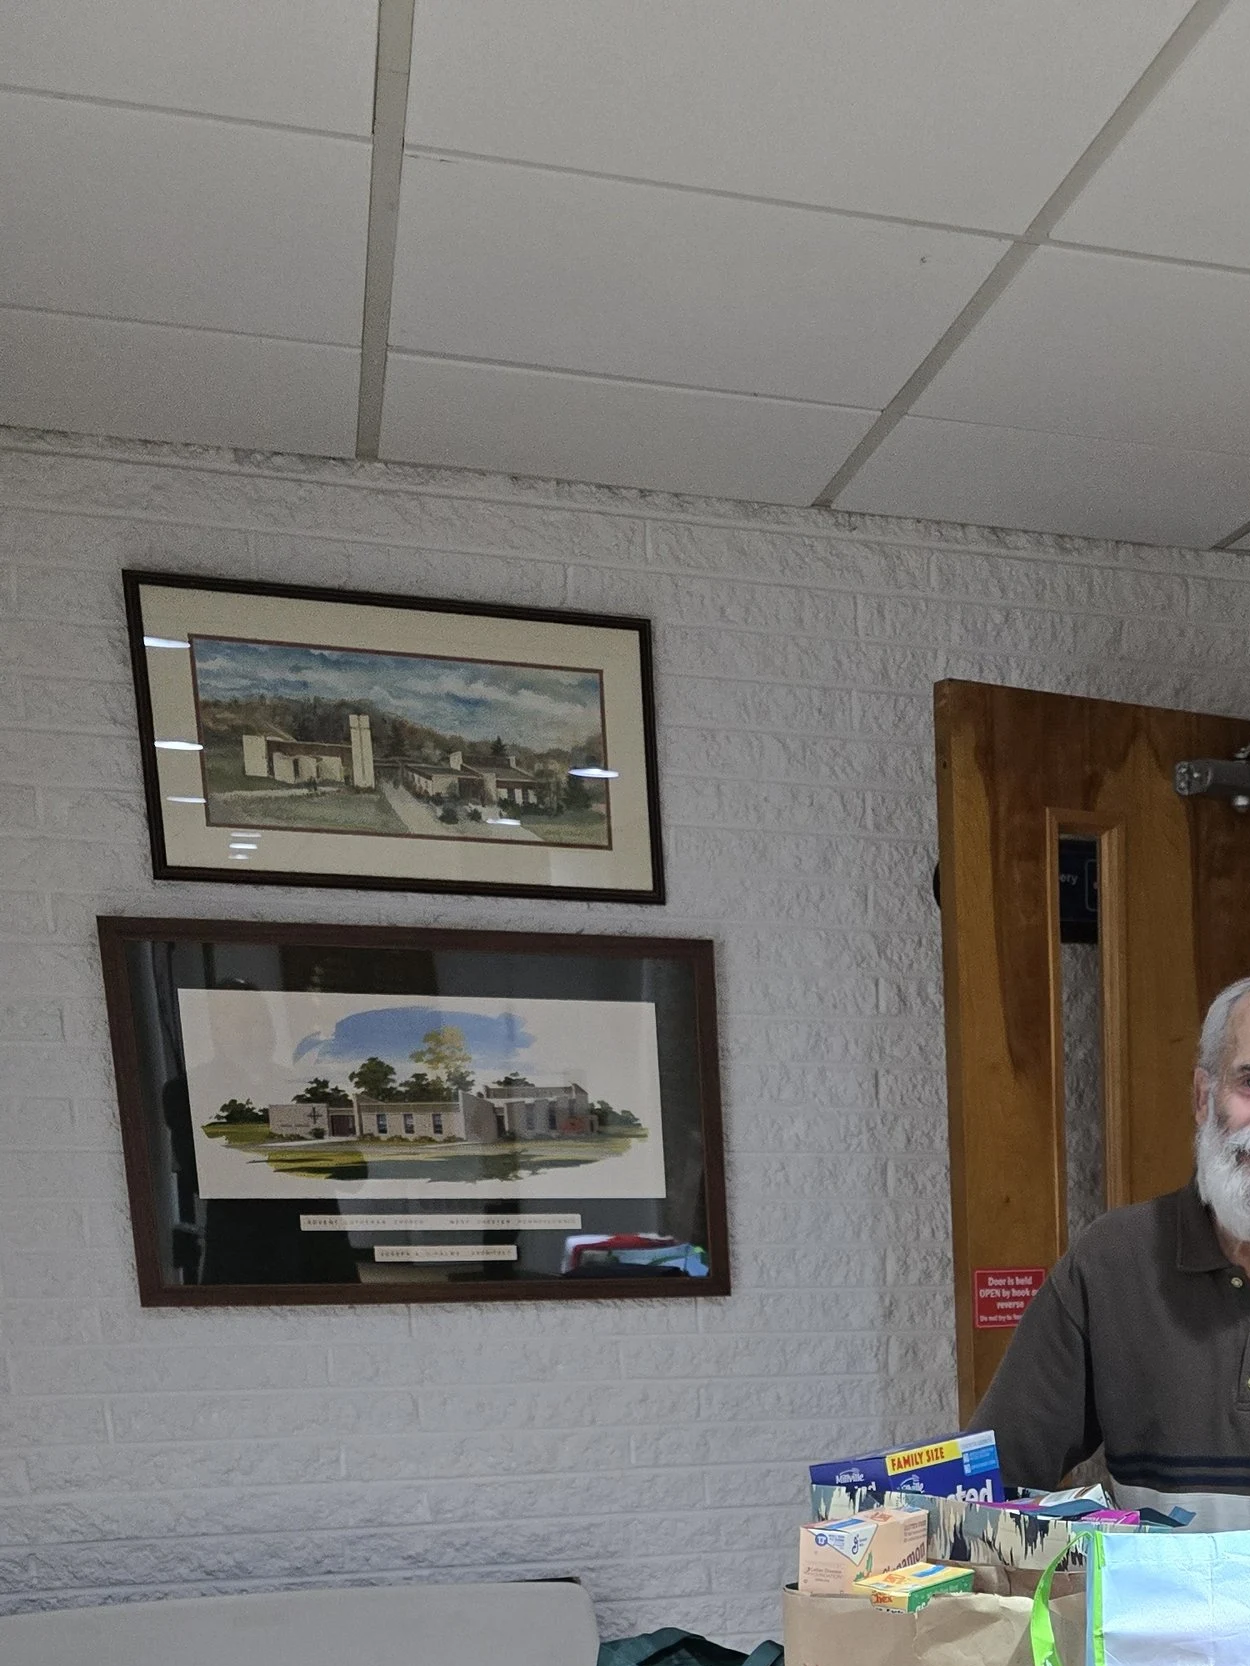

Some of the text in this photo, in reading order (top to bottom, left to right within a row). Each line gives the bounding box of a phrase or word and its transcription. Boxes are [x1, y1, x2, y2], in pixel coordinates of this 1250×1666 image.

[988, 1276, 1032, 1286] Door is held
[979, 1289, 1000, 1298] OPEN
[1002, 1289, 1010, 1299] by
[891, 1447, 945, 1472] FAMILY SIZE
